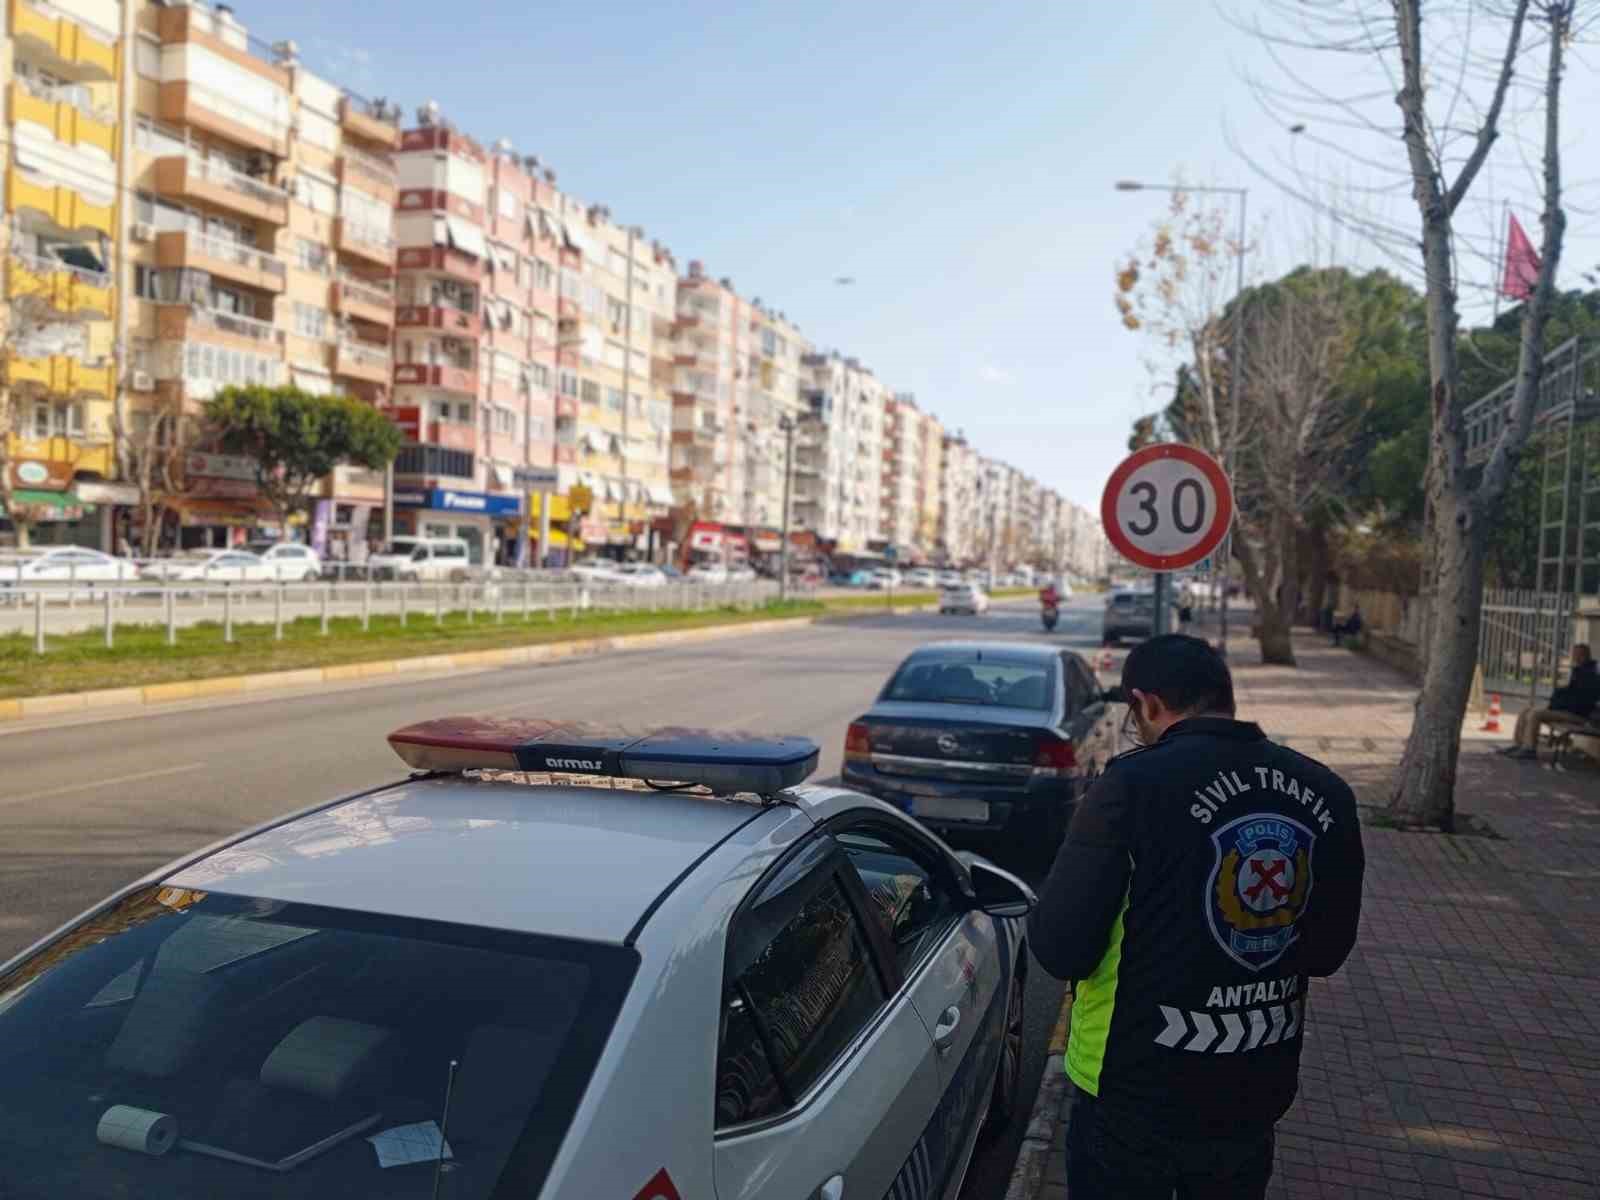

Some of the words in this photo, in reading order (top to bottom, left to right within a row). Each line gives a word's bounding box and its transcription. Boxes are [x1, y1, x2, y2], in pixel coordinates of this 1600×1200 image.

[1128, 478, 1205, 536] 30
[545, 757, 602, 770] armas
[1190, 771, 1250, 824] SİVİL
